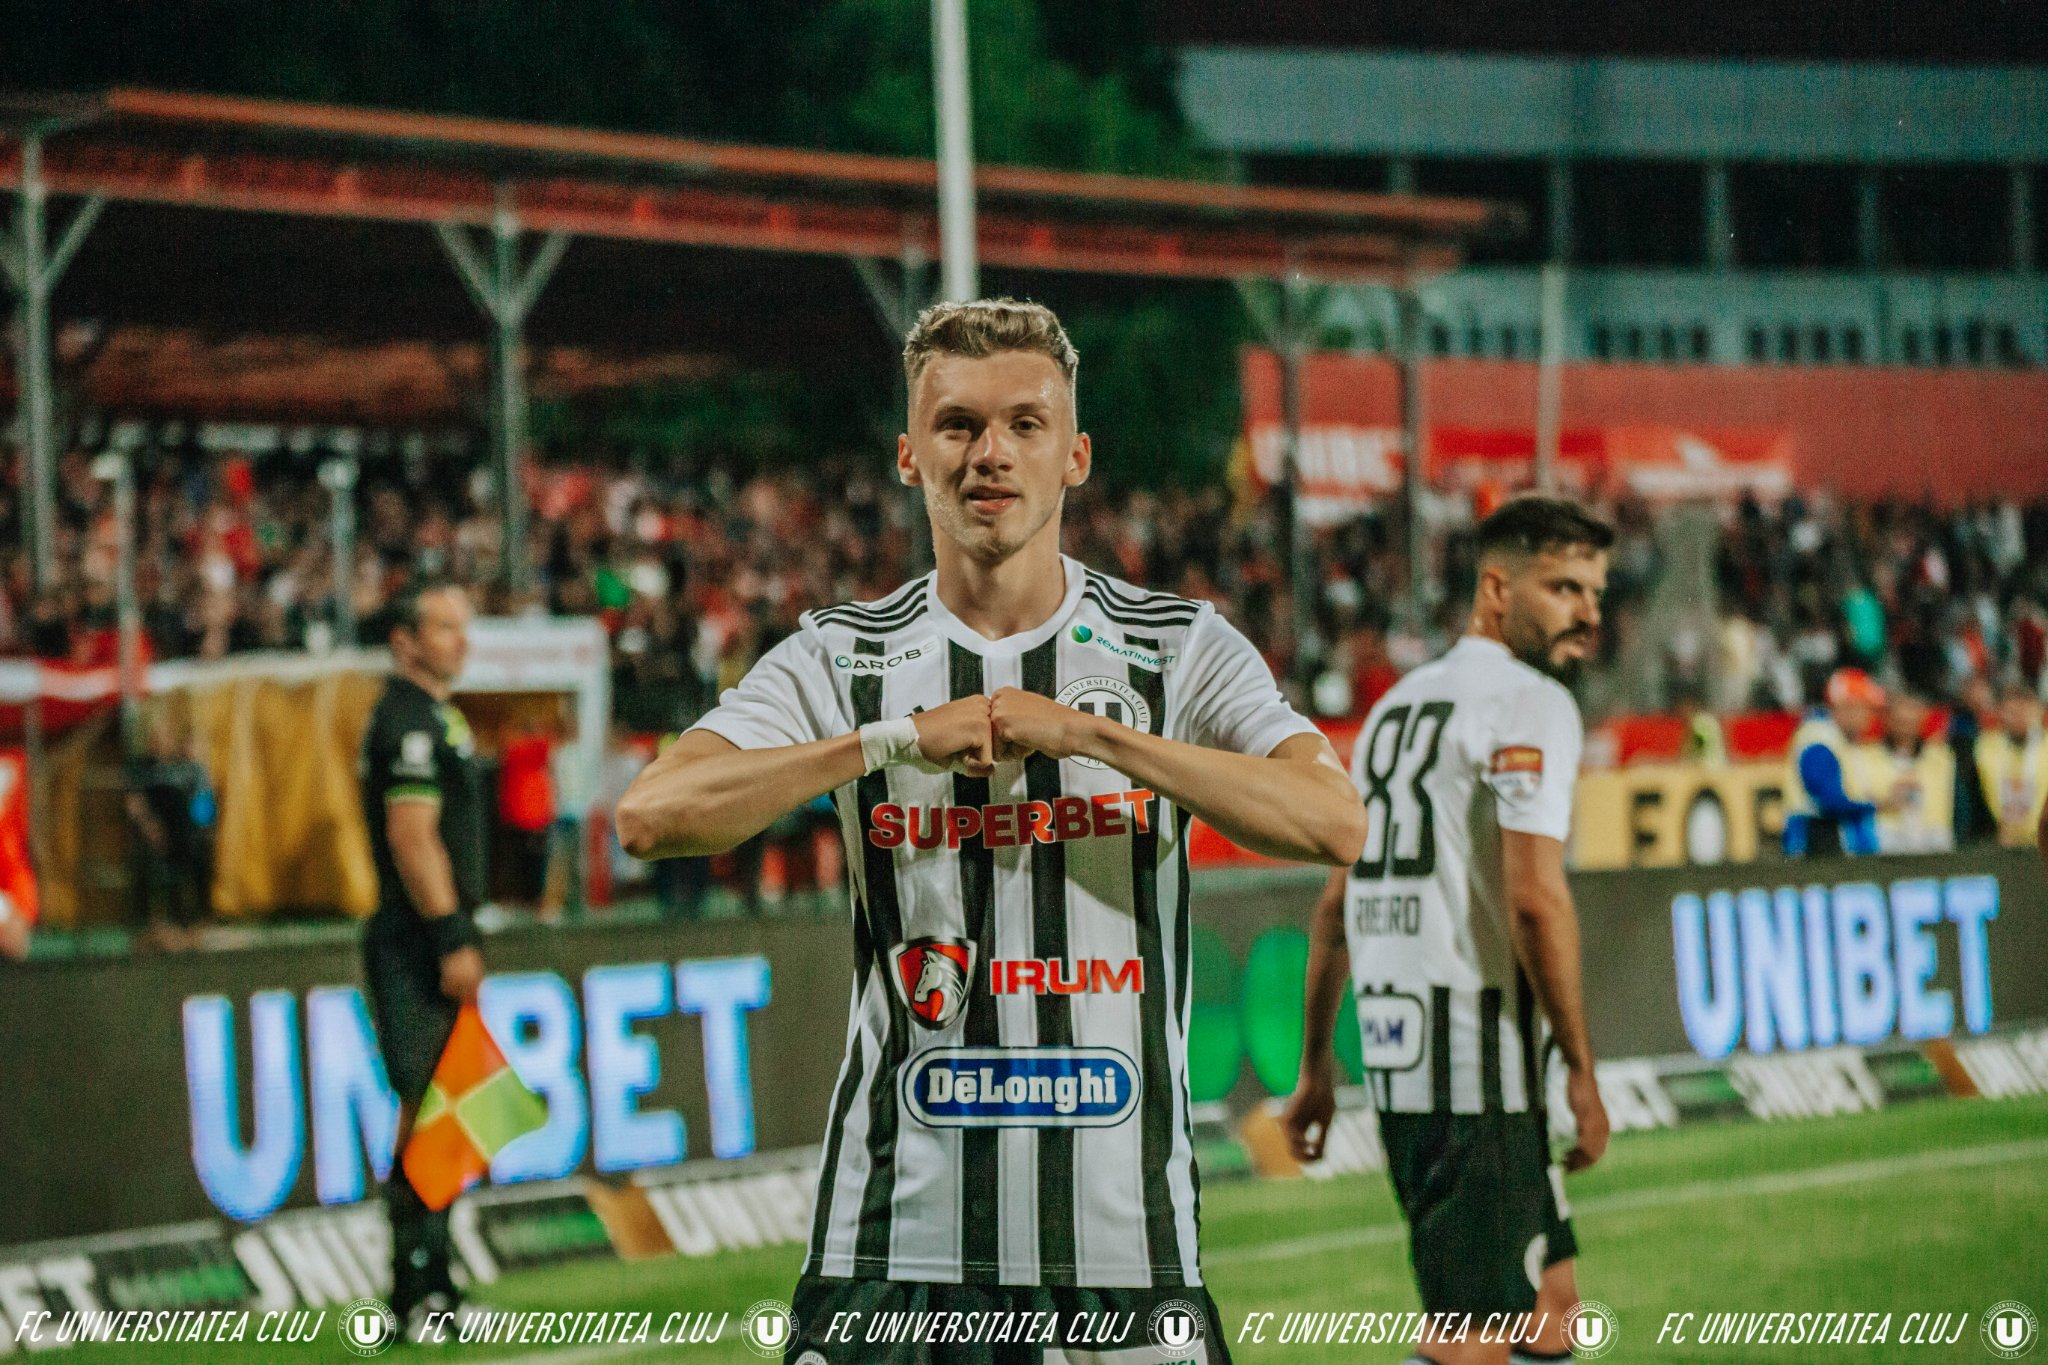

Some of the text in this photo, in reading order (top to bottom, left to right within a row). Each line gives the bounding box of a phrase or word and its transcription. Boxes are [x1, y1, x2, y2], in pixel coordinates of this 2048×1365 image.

[853, 640, 937, 670] AROBS
[868, 788, 1155, 850] SUPERBET
[1353, 701, 1455, 880] 83
[990, 956, 1145, 996] IRUM
[1671, 873, 2000, 1061] UNIBET
[183, 954, 772, 1222] UNBET
